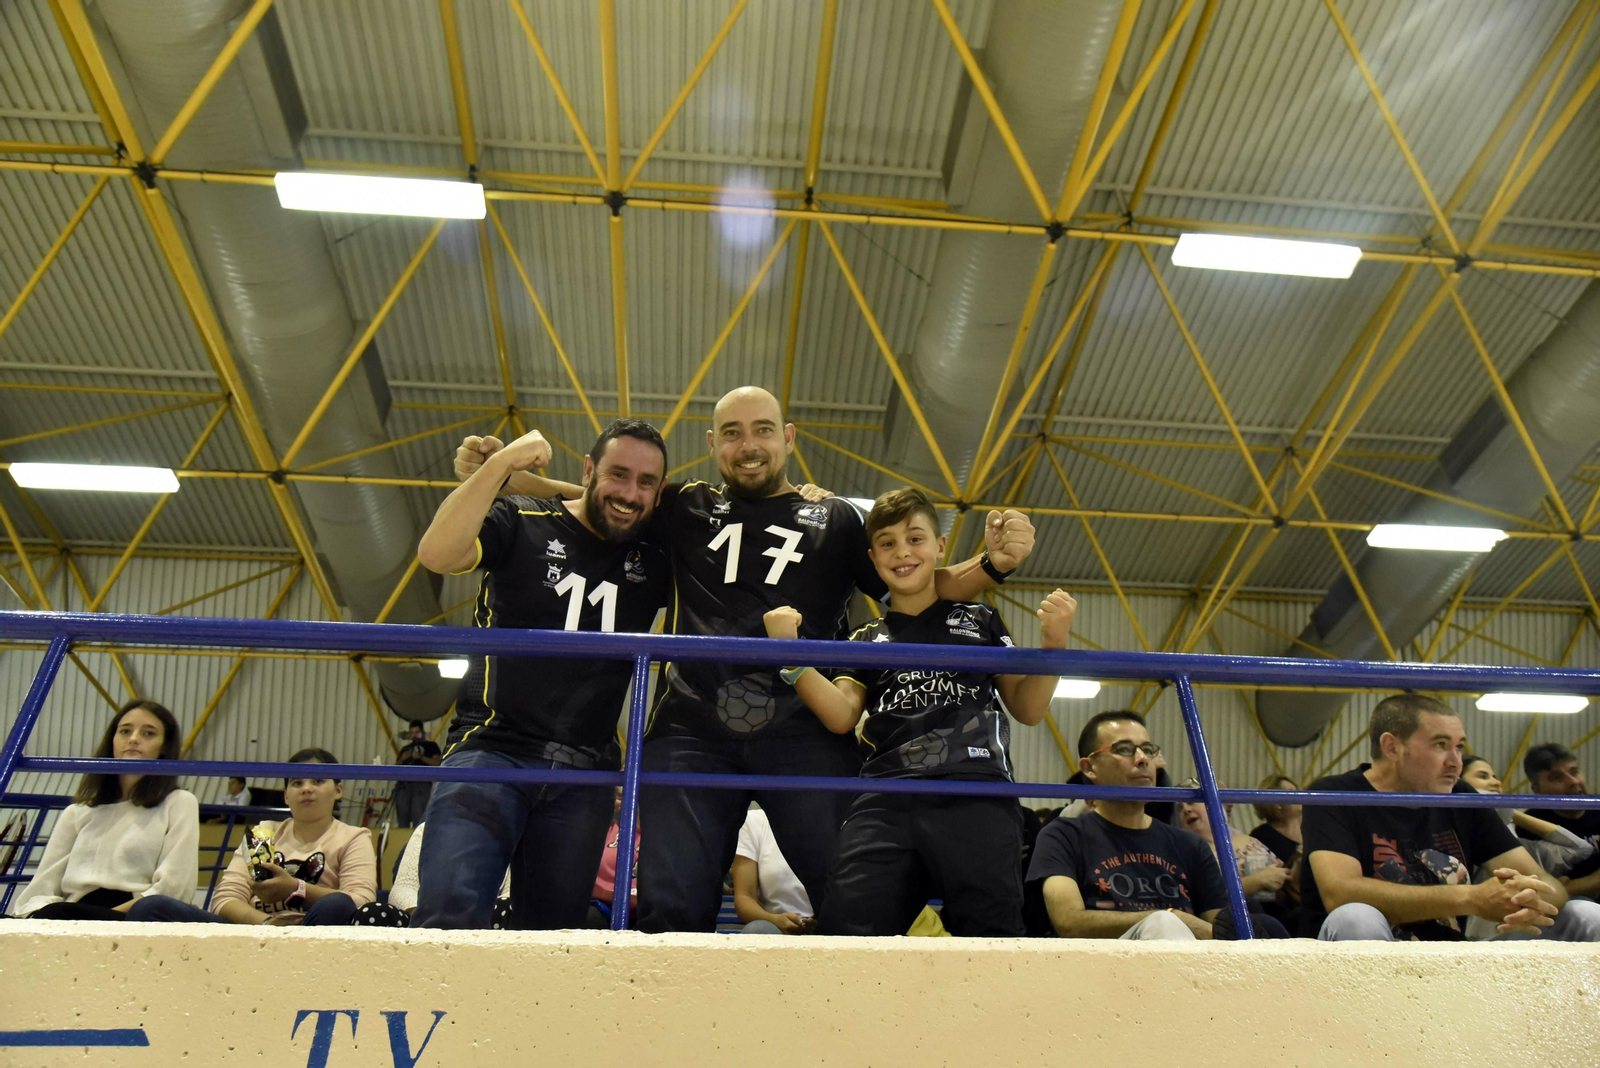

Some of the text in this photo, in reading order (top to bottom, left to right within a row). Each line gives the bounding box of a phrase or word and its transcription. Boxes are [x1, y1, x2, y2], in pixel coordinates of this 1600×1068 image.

[707, 523, 804, 585] 17
[554, 572, 618, 632] 11
[1101, 853, 1177, 874] THE AUTHENTIC
[255, 900, 308, 913] FELI
